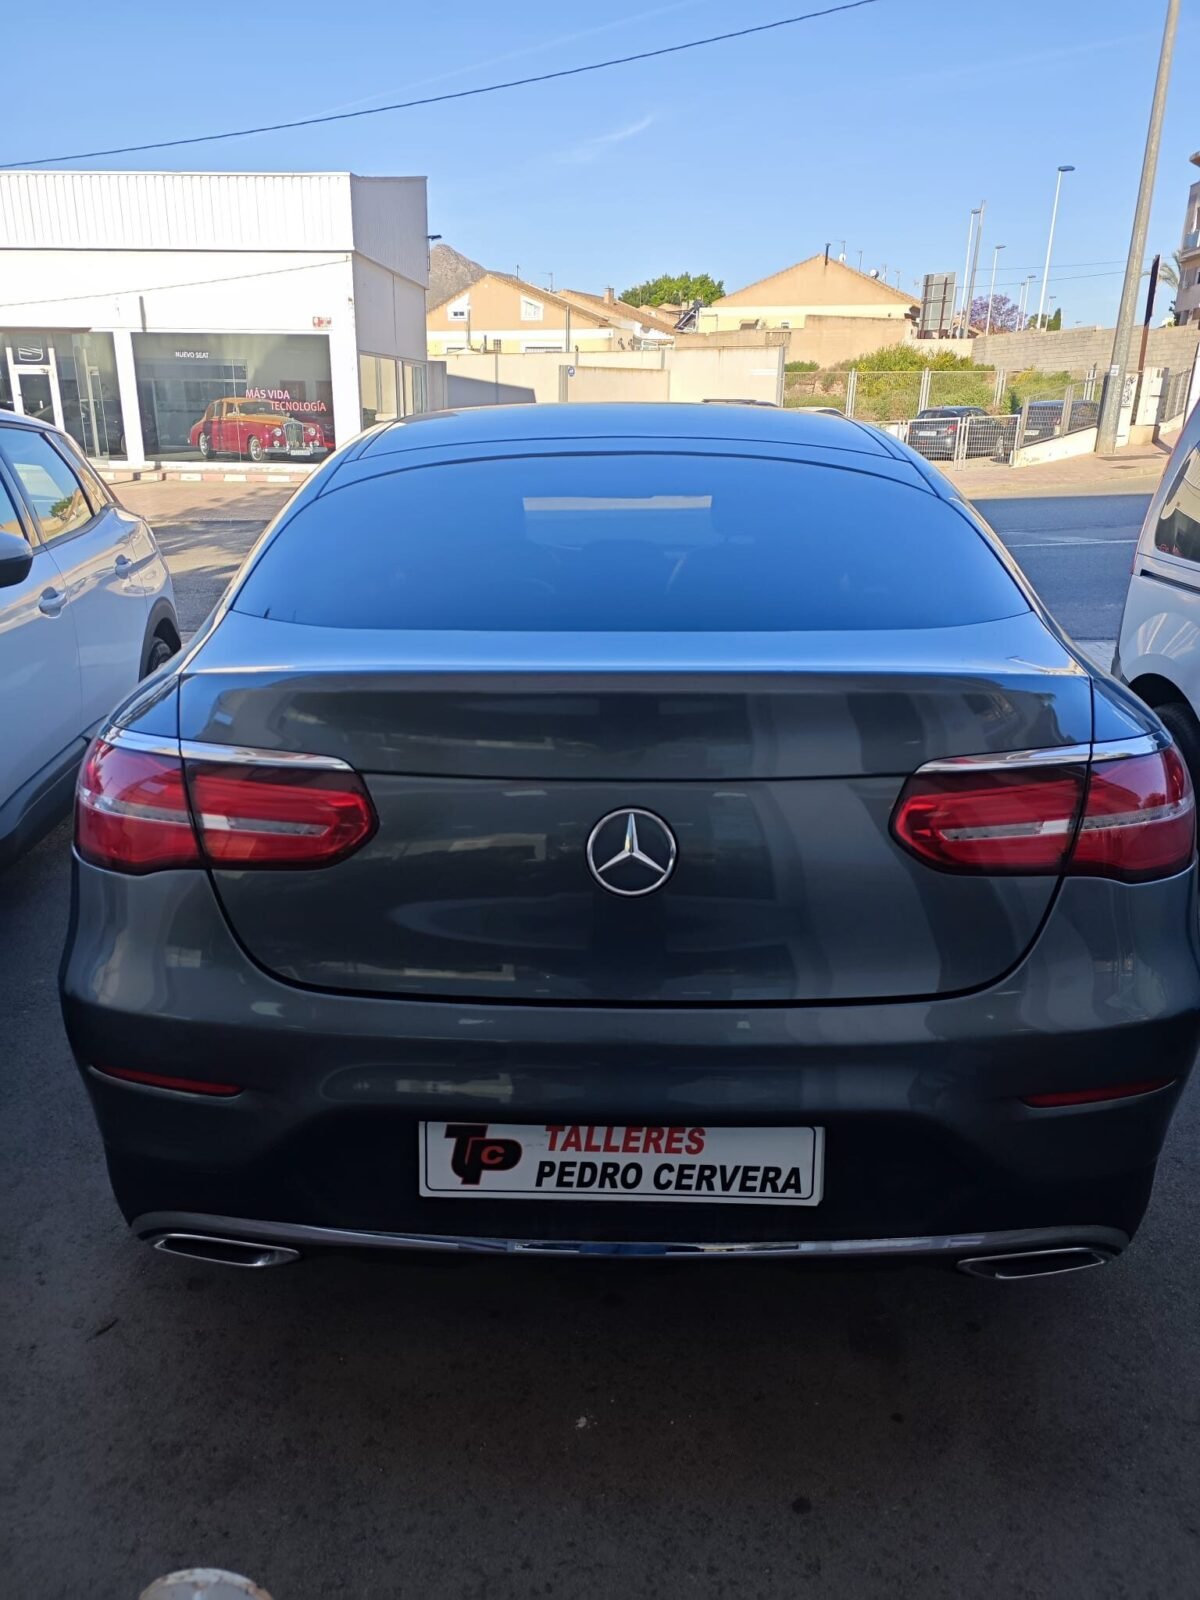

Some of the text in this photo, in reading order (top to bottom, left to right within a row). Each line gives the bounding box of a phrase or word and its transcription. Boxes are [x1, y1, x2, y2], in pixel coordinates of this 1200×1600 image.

[195, 351, 209, 359] SEAT
[245, 387, 290, 400] MÁS VIDA
[271, 400, 327, 412] TECNOLOGÍA
[545, 1124, 706, 1155] TALLERES
[535, 1160, 802, 1194] PEDRO CERVERA
